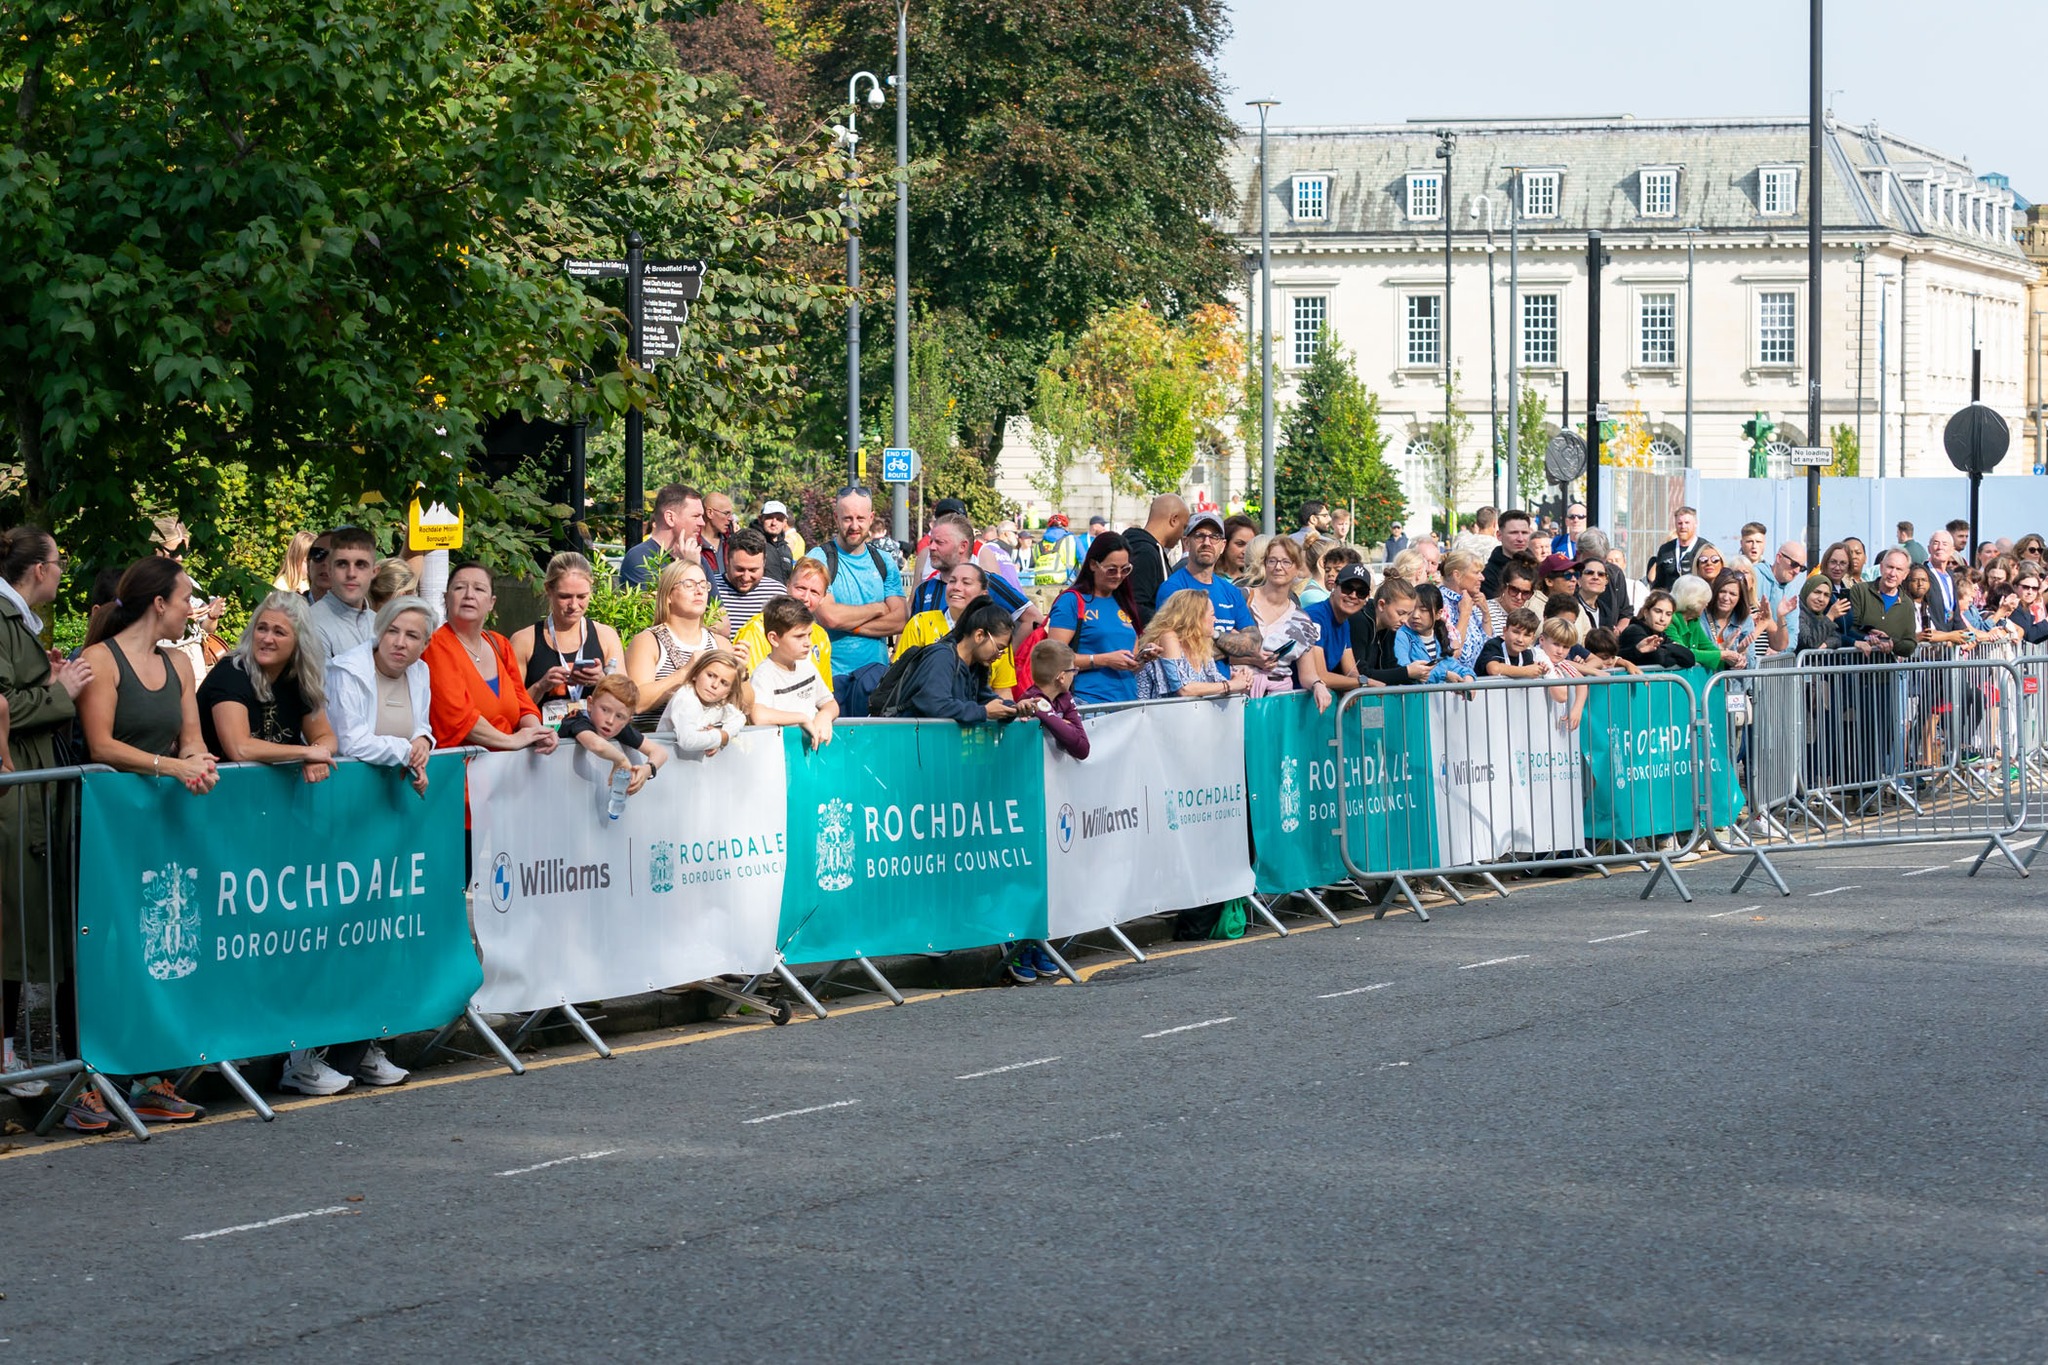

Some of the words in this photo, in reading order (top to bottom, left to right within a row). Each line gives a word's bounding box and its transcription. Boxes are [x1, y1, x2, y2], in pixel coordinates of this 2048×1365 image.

[1806, 449, 1829, 457] loading
[1178, 784, 1241, 808] ROCHDALE
[865, 799, 1024, 843] ROCHDALE
[1082, 806, 1139, 839] Williams
[1180, 812, 1212, 825] BOROUGH
[1215, 807, 1241, 820] COUNCIL
[680, 833, 785, 865] ROCHDALE
[867, 854, 946, 879] BOROUGH
[954, 847, 1032, 872] COUNCIL
[217, 852, 425, 916] ROCHDALE
[519, 858, 611, 897] Williams
[682, 868, 731, 885] BOROUGH
[216, 926, 328, 961] BOROUGH
[338, 913, 425, 947] COUNCIL
